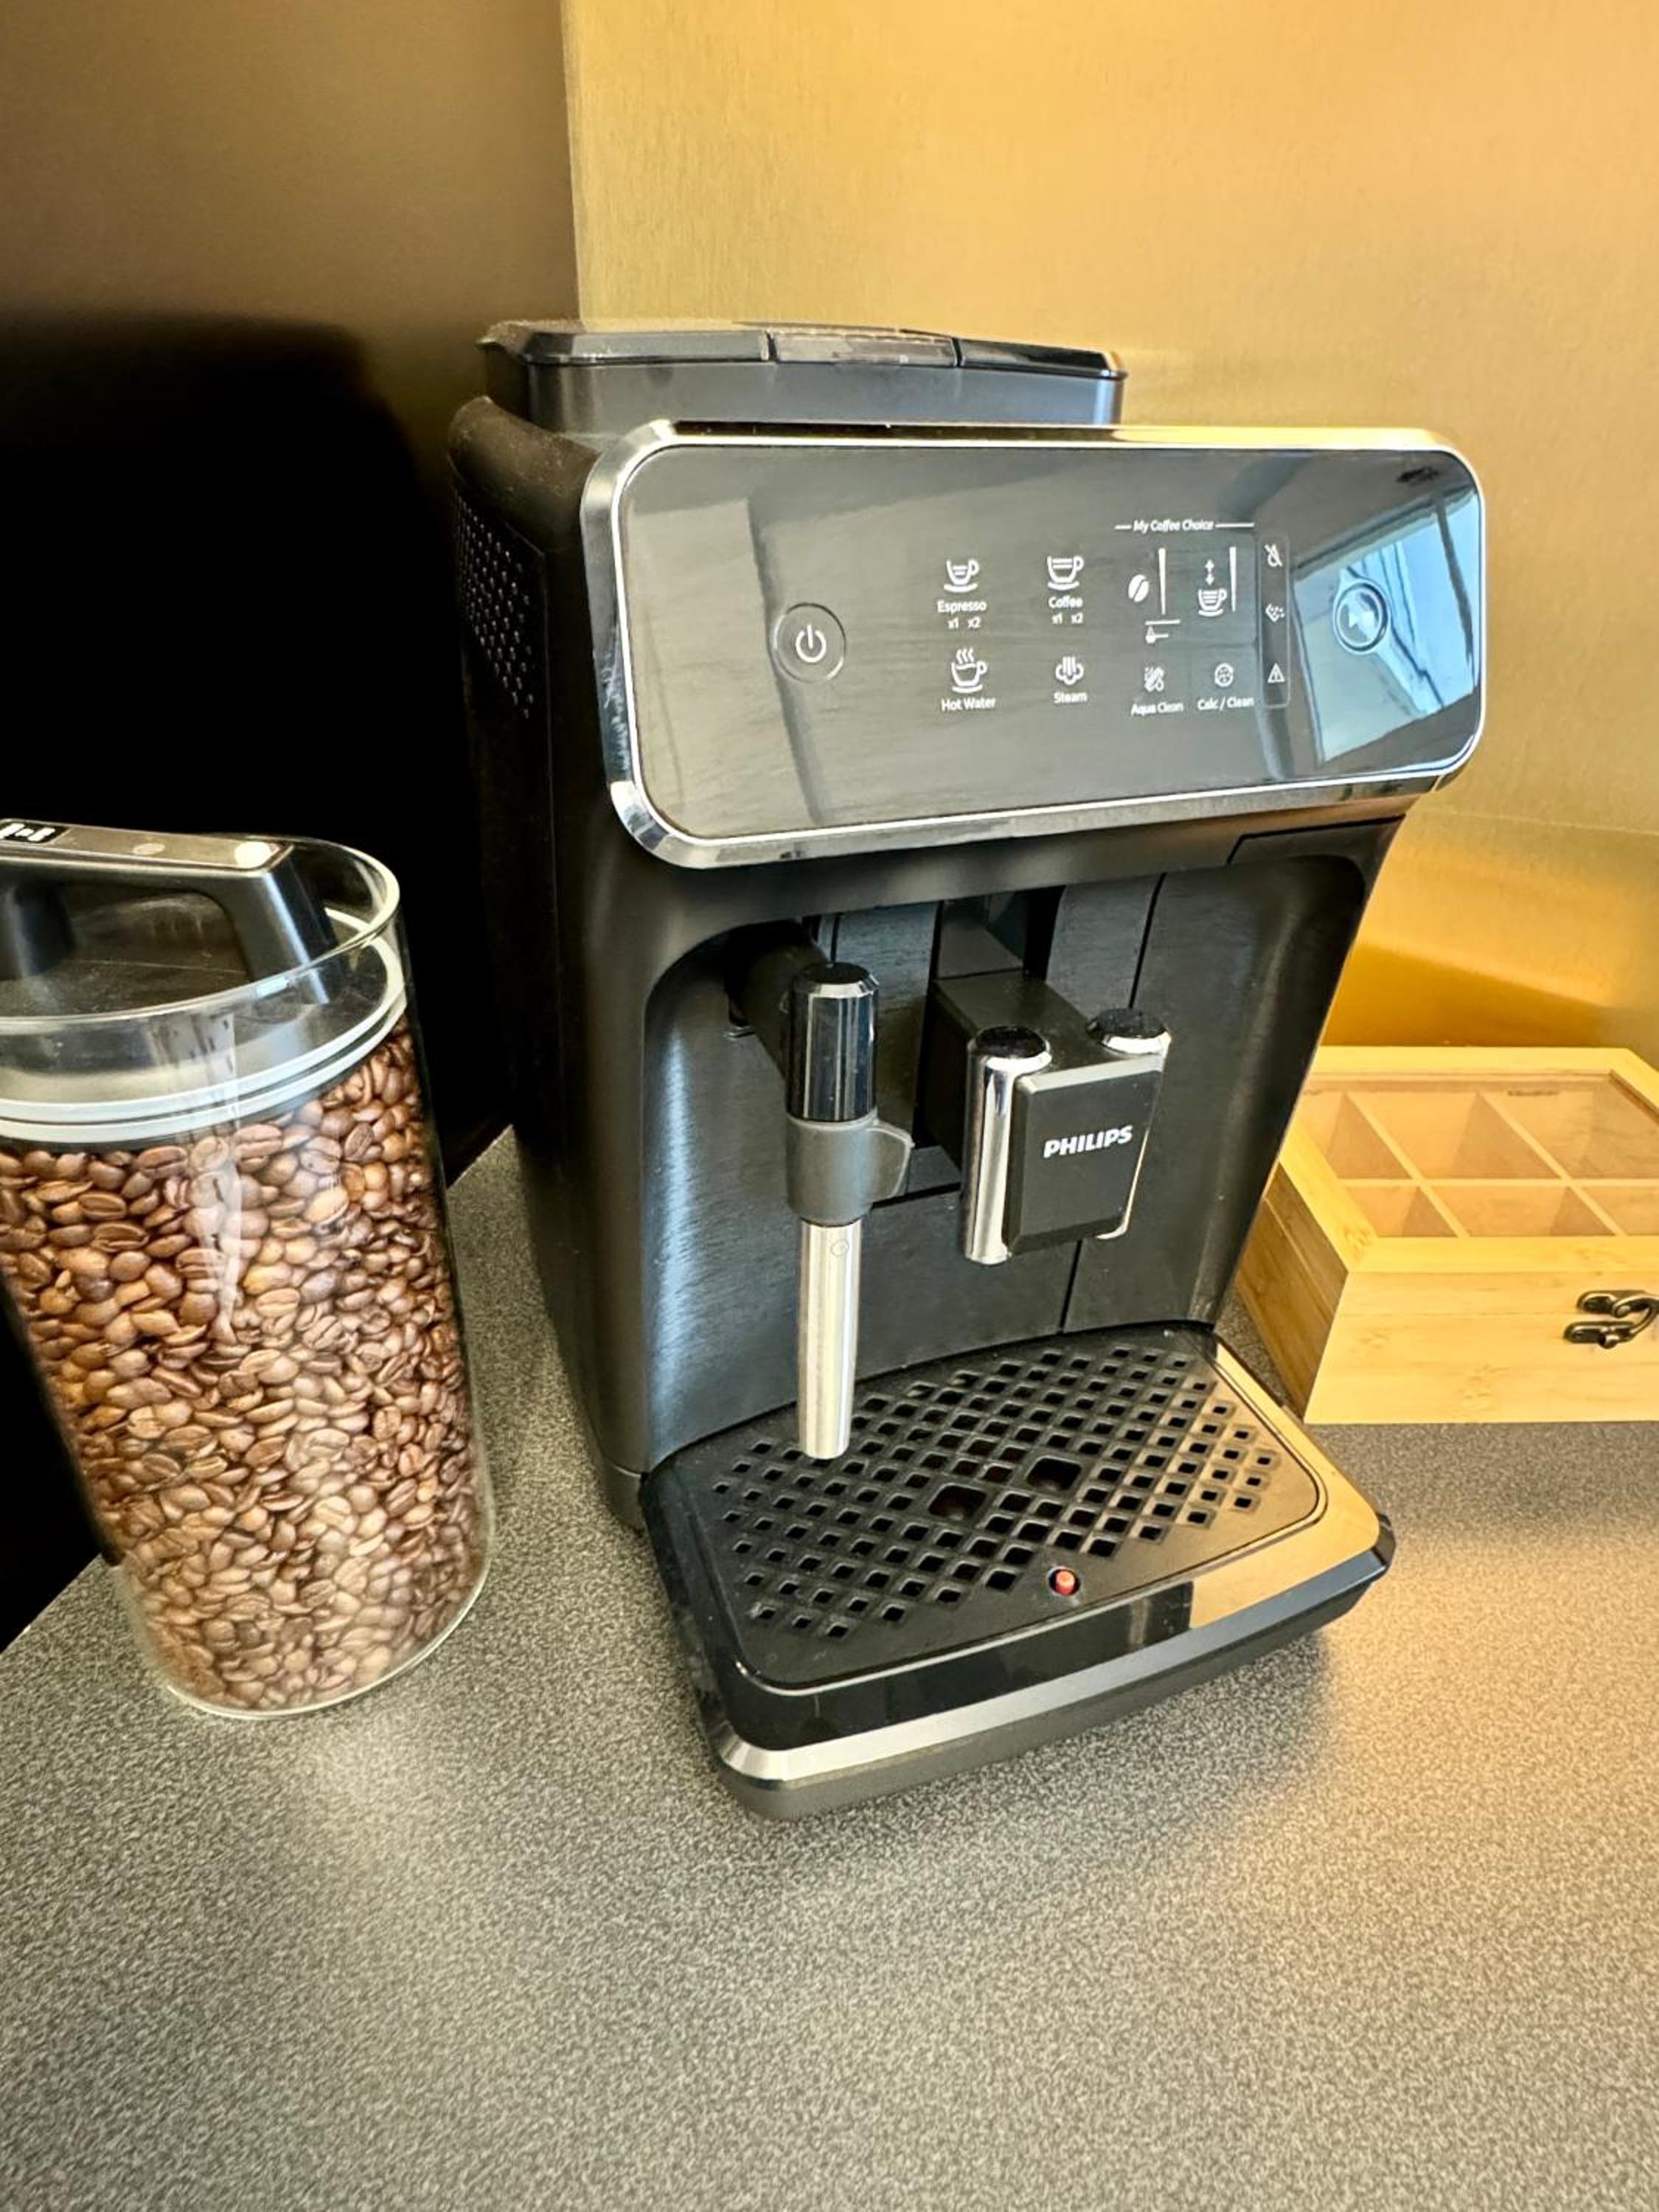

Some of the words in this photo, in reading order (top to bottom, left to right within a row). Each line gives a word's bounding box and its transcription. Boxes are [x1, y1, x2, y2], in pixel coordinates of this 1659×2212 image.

[1133, 519, 1149, 534] My
[1150, 519, 1180, 532] Coffee
[1182, 518, 1214, 532] Choice
[937, 599, 987, 613] Espresso
[1048, 596, 1083, 608] Coffee
[947, 617, 959, 629] x1
[967, 616, 981, 628] x2
[1071, 612, 1083, 624] x2
[942, 698, 962, 712] Hot
[963, 697, 995, 711] Water
[1054, 692, 1088, 703] Steam
[1197, 698, 1218, 711] Calc
[1227, 696, 1254, 709] Clean
[1131, 703, 1157, 716] Aqua
[1157, 702, 1184, 713] Clean
[1043, 1124, 1133, 1158] PHILIPS
